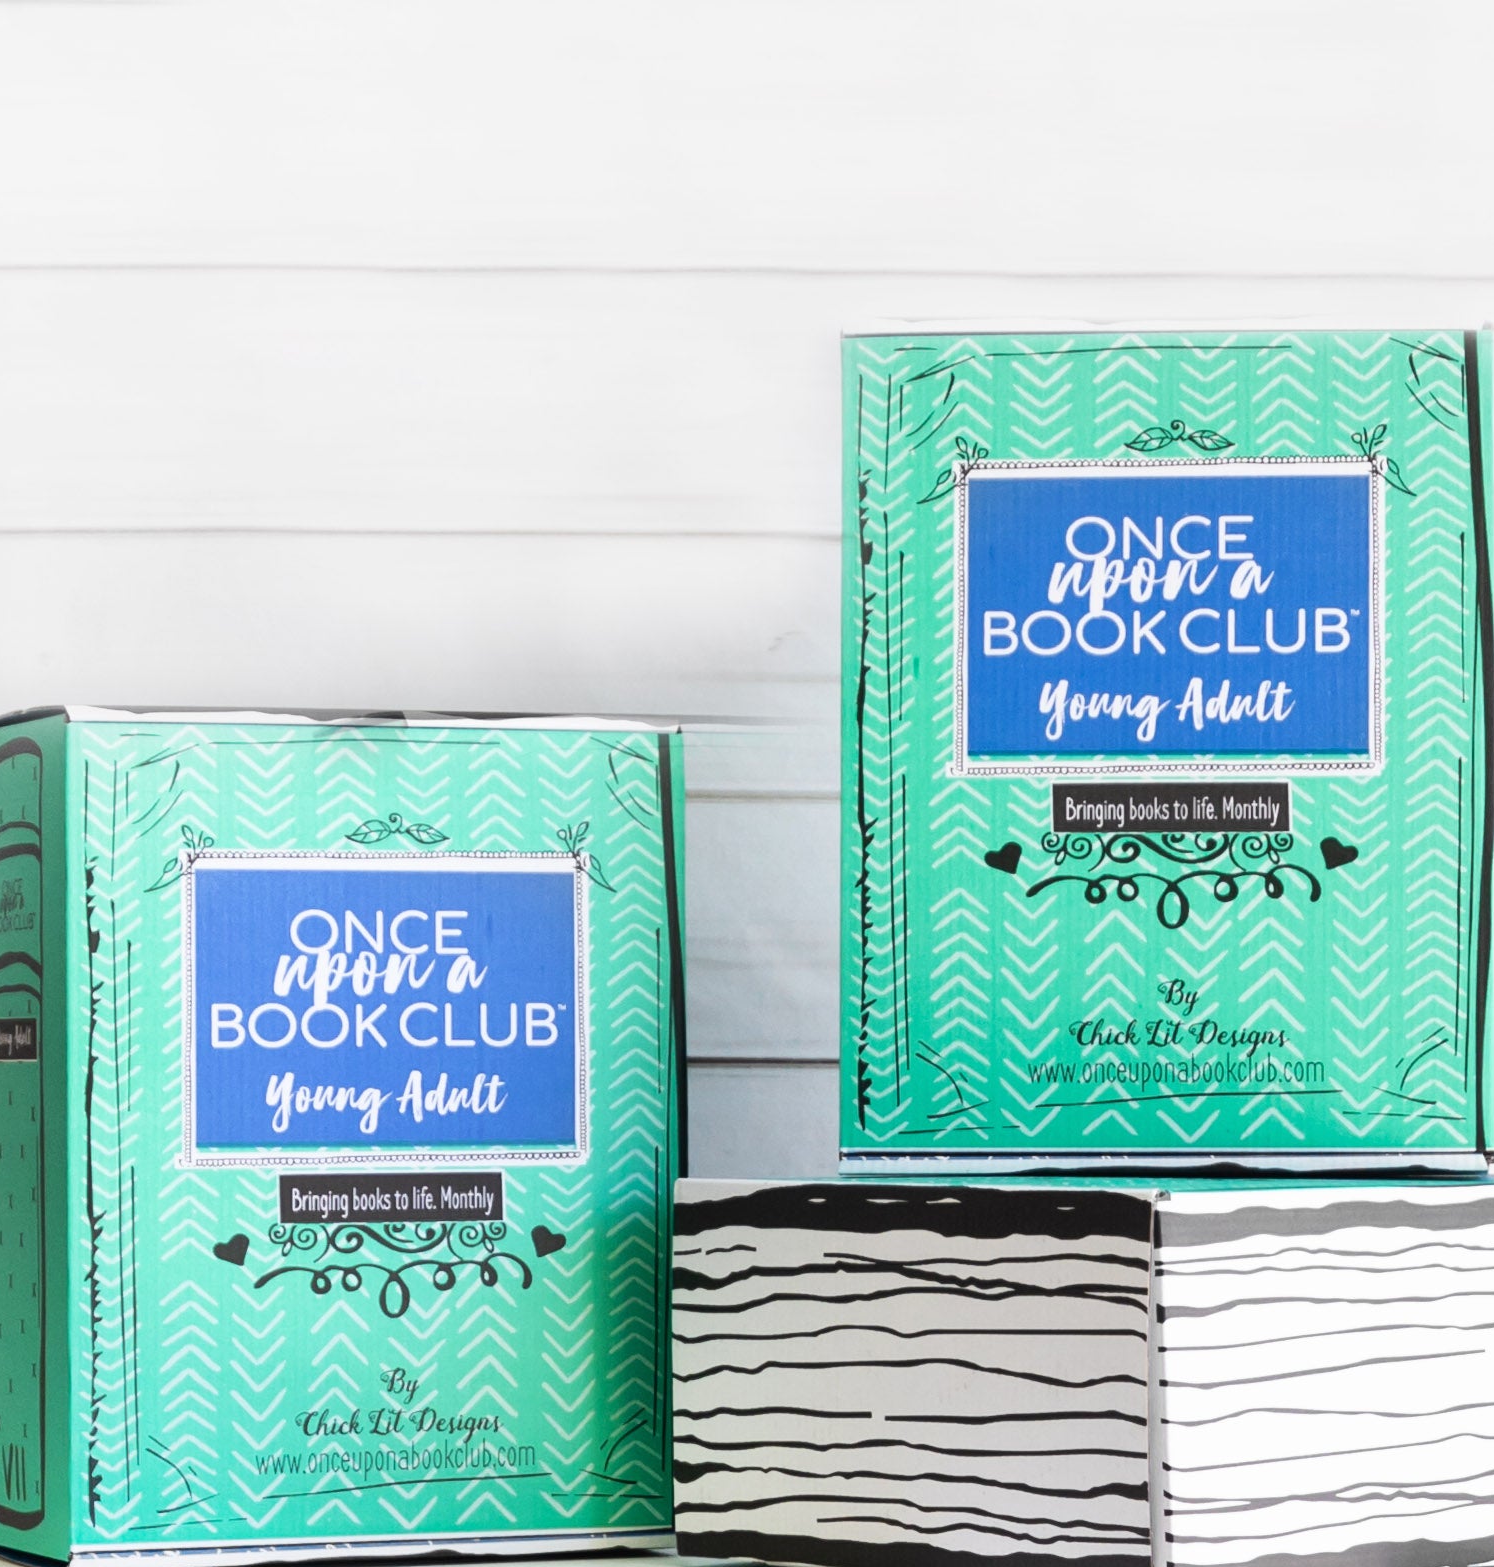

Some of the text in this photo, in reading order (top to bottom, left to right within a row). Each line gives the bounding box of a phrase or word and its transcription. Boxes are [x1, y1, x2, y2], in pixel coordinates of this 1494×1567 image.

[1065, 515, 1254, 561] ONCE
[1048, 557, 1274, 616] upon a
[983, 610, 1166, 656] BOOK
[1039, 677, 1296, 742] Young Adult
[1065, 795, 1280, 828] Bringing books to life. Monthly
[290, 909, 468, 954] ONCE
[273, 949, 487, 1007] upon a
[1157, 979, 1199, 1016] By
[211, 1003, 387, 1048] BOOK
[1068, 1019, 1290, 1058] Chick Lit Designs
[1027, 1052, 1325, 1092] www.onceuponabookclub.com
[265, 1070, 508, 1133] Young Adult
[291, 1186, 494, 1218] Bringing books to life. Monthly
[380, 1368, 419, 1404] By
[295, 1407, 504, 1443] Chick Lit Designs
[2, 1443, 27, 1502] VII
[256, 1439, 536, 1481] www.onceuponabookclub.com
